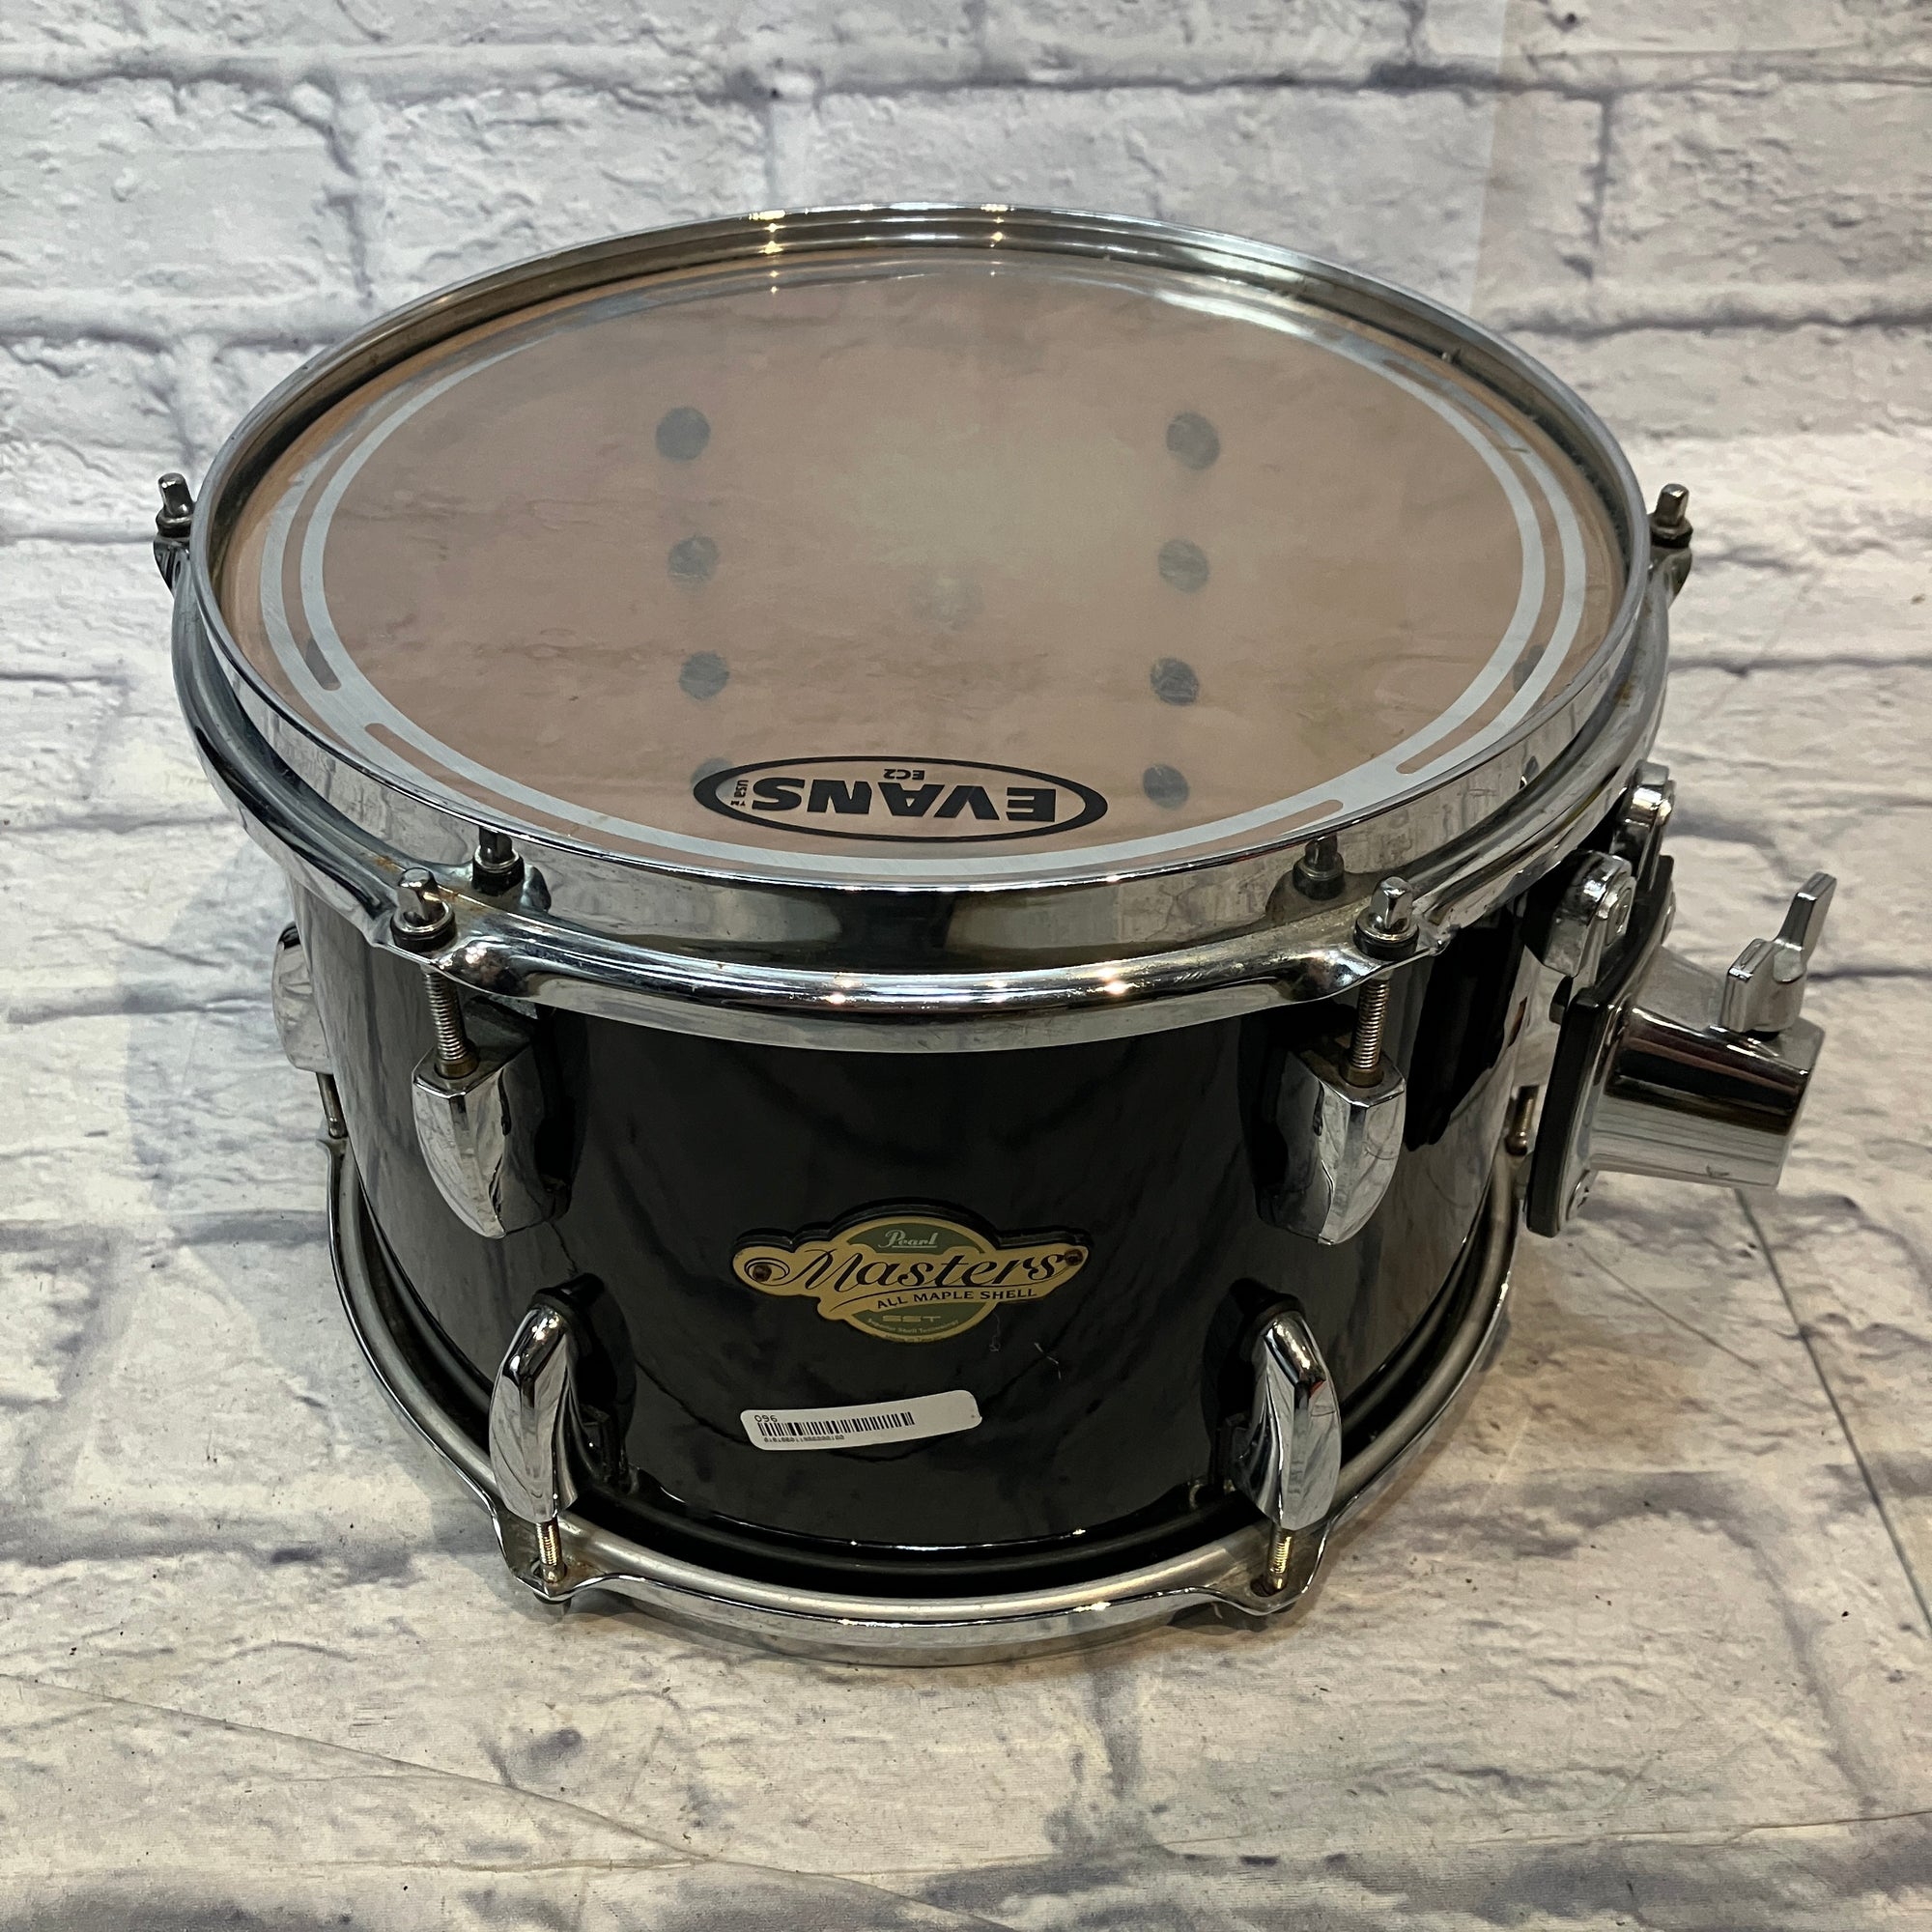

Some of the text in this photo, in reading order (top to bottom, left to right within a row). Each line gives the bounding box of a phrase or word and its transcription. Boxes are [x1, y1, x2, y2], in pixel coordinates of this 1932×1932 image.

[883, 768, 925, 781] EC2
[752, 778, 1056, 822] EVANS
[878, 1229, 938, 1249] Pearl
[747, 1248, 1070, 1293] Masters
[877, 1288, 1037, 1310] ALL MAPLE SHELL
